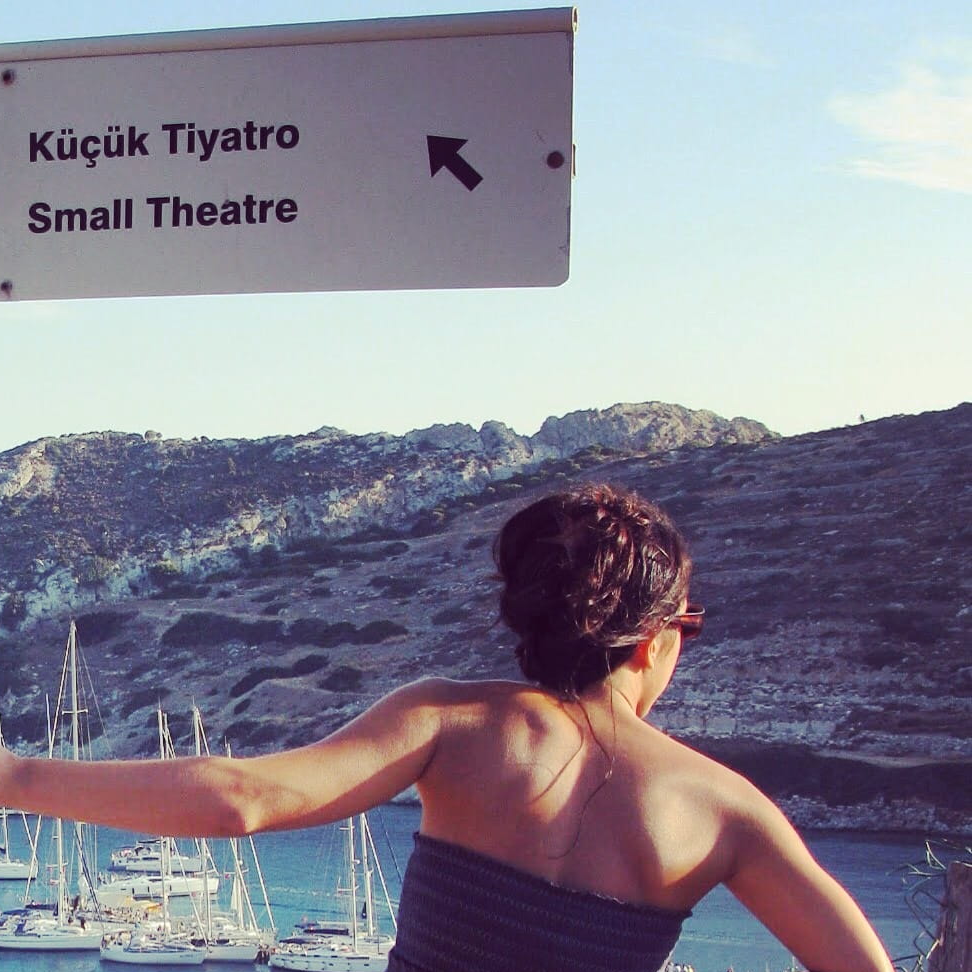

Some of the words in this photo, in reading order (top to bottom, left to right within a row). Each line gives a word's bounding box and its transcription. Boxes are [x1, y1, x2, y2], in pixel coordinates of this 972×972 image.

[29, 125, 150, 168] Küçük
[162, 121, 300, 162] Tiyatro
[28, 198, 133, 234] Small
[146, 194, 299, 228] Theatre
